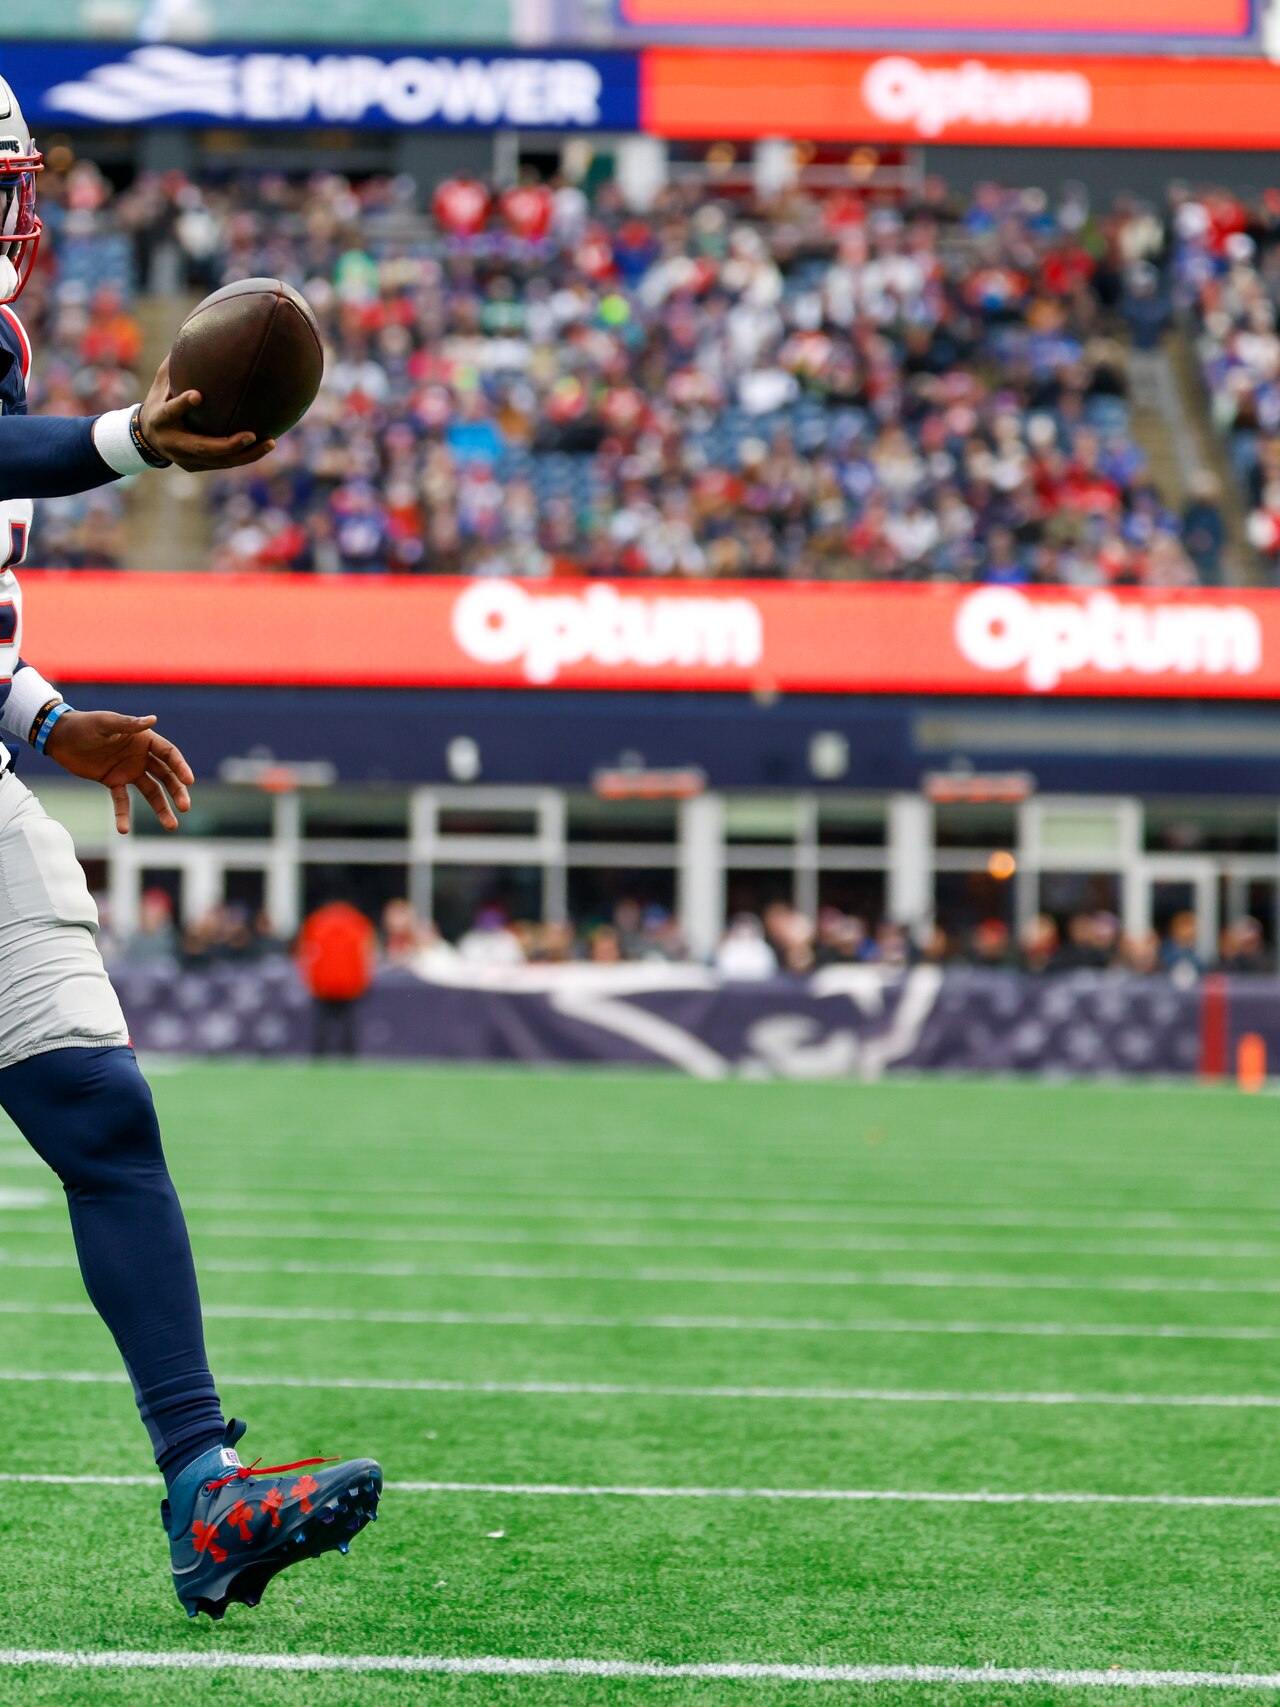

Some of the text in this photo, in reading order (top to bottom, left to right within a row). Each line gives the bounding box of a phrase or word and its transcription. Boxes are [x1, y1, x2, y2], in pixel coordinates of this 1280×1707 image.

[237, 54, 603, 126] EMPOWER
[861, 56, 1092, 136] Optum
[452, 579, 762, 682] Optum
[955, 586, 1261, 690] Optum
